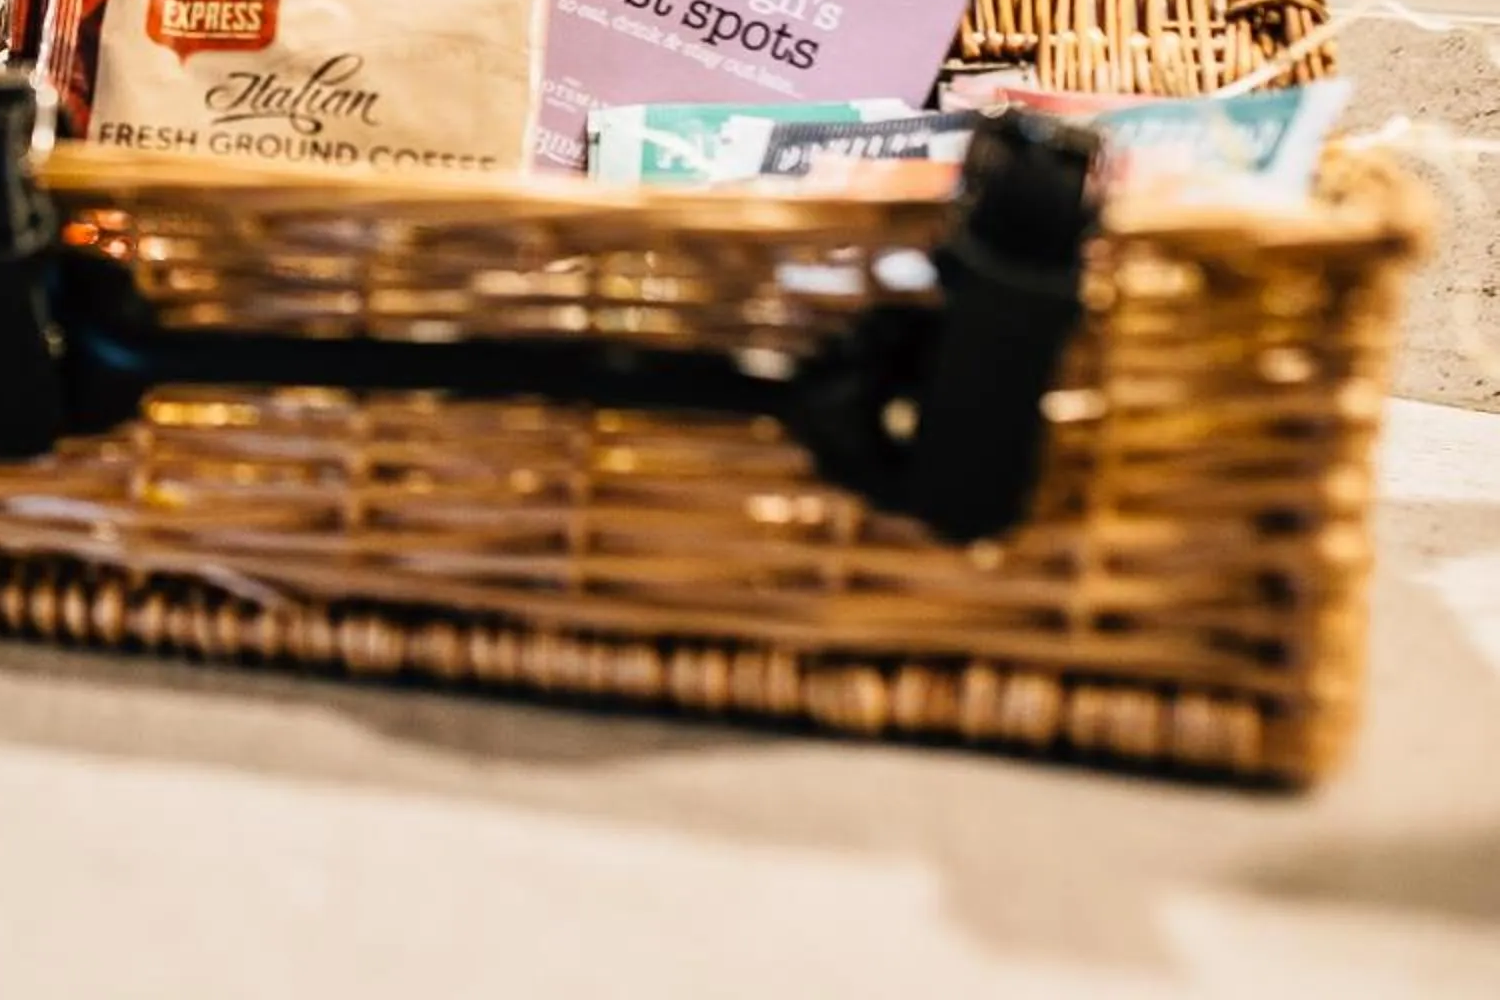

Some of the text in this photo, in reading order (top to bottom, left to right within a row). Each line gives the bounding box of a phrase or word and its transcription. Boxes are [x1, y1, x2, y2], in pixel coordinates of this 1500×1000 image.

[163, 0, 263, 31] EXPRESS
[205, 53, 383, 135] Italian
[99, 122, 198, 151] FRESH
[209, 131, 359, 166] GROUND
